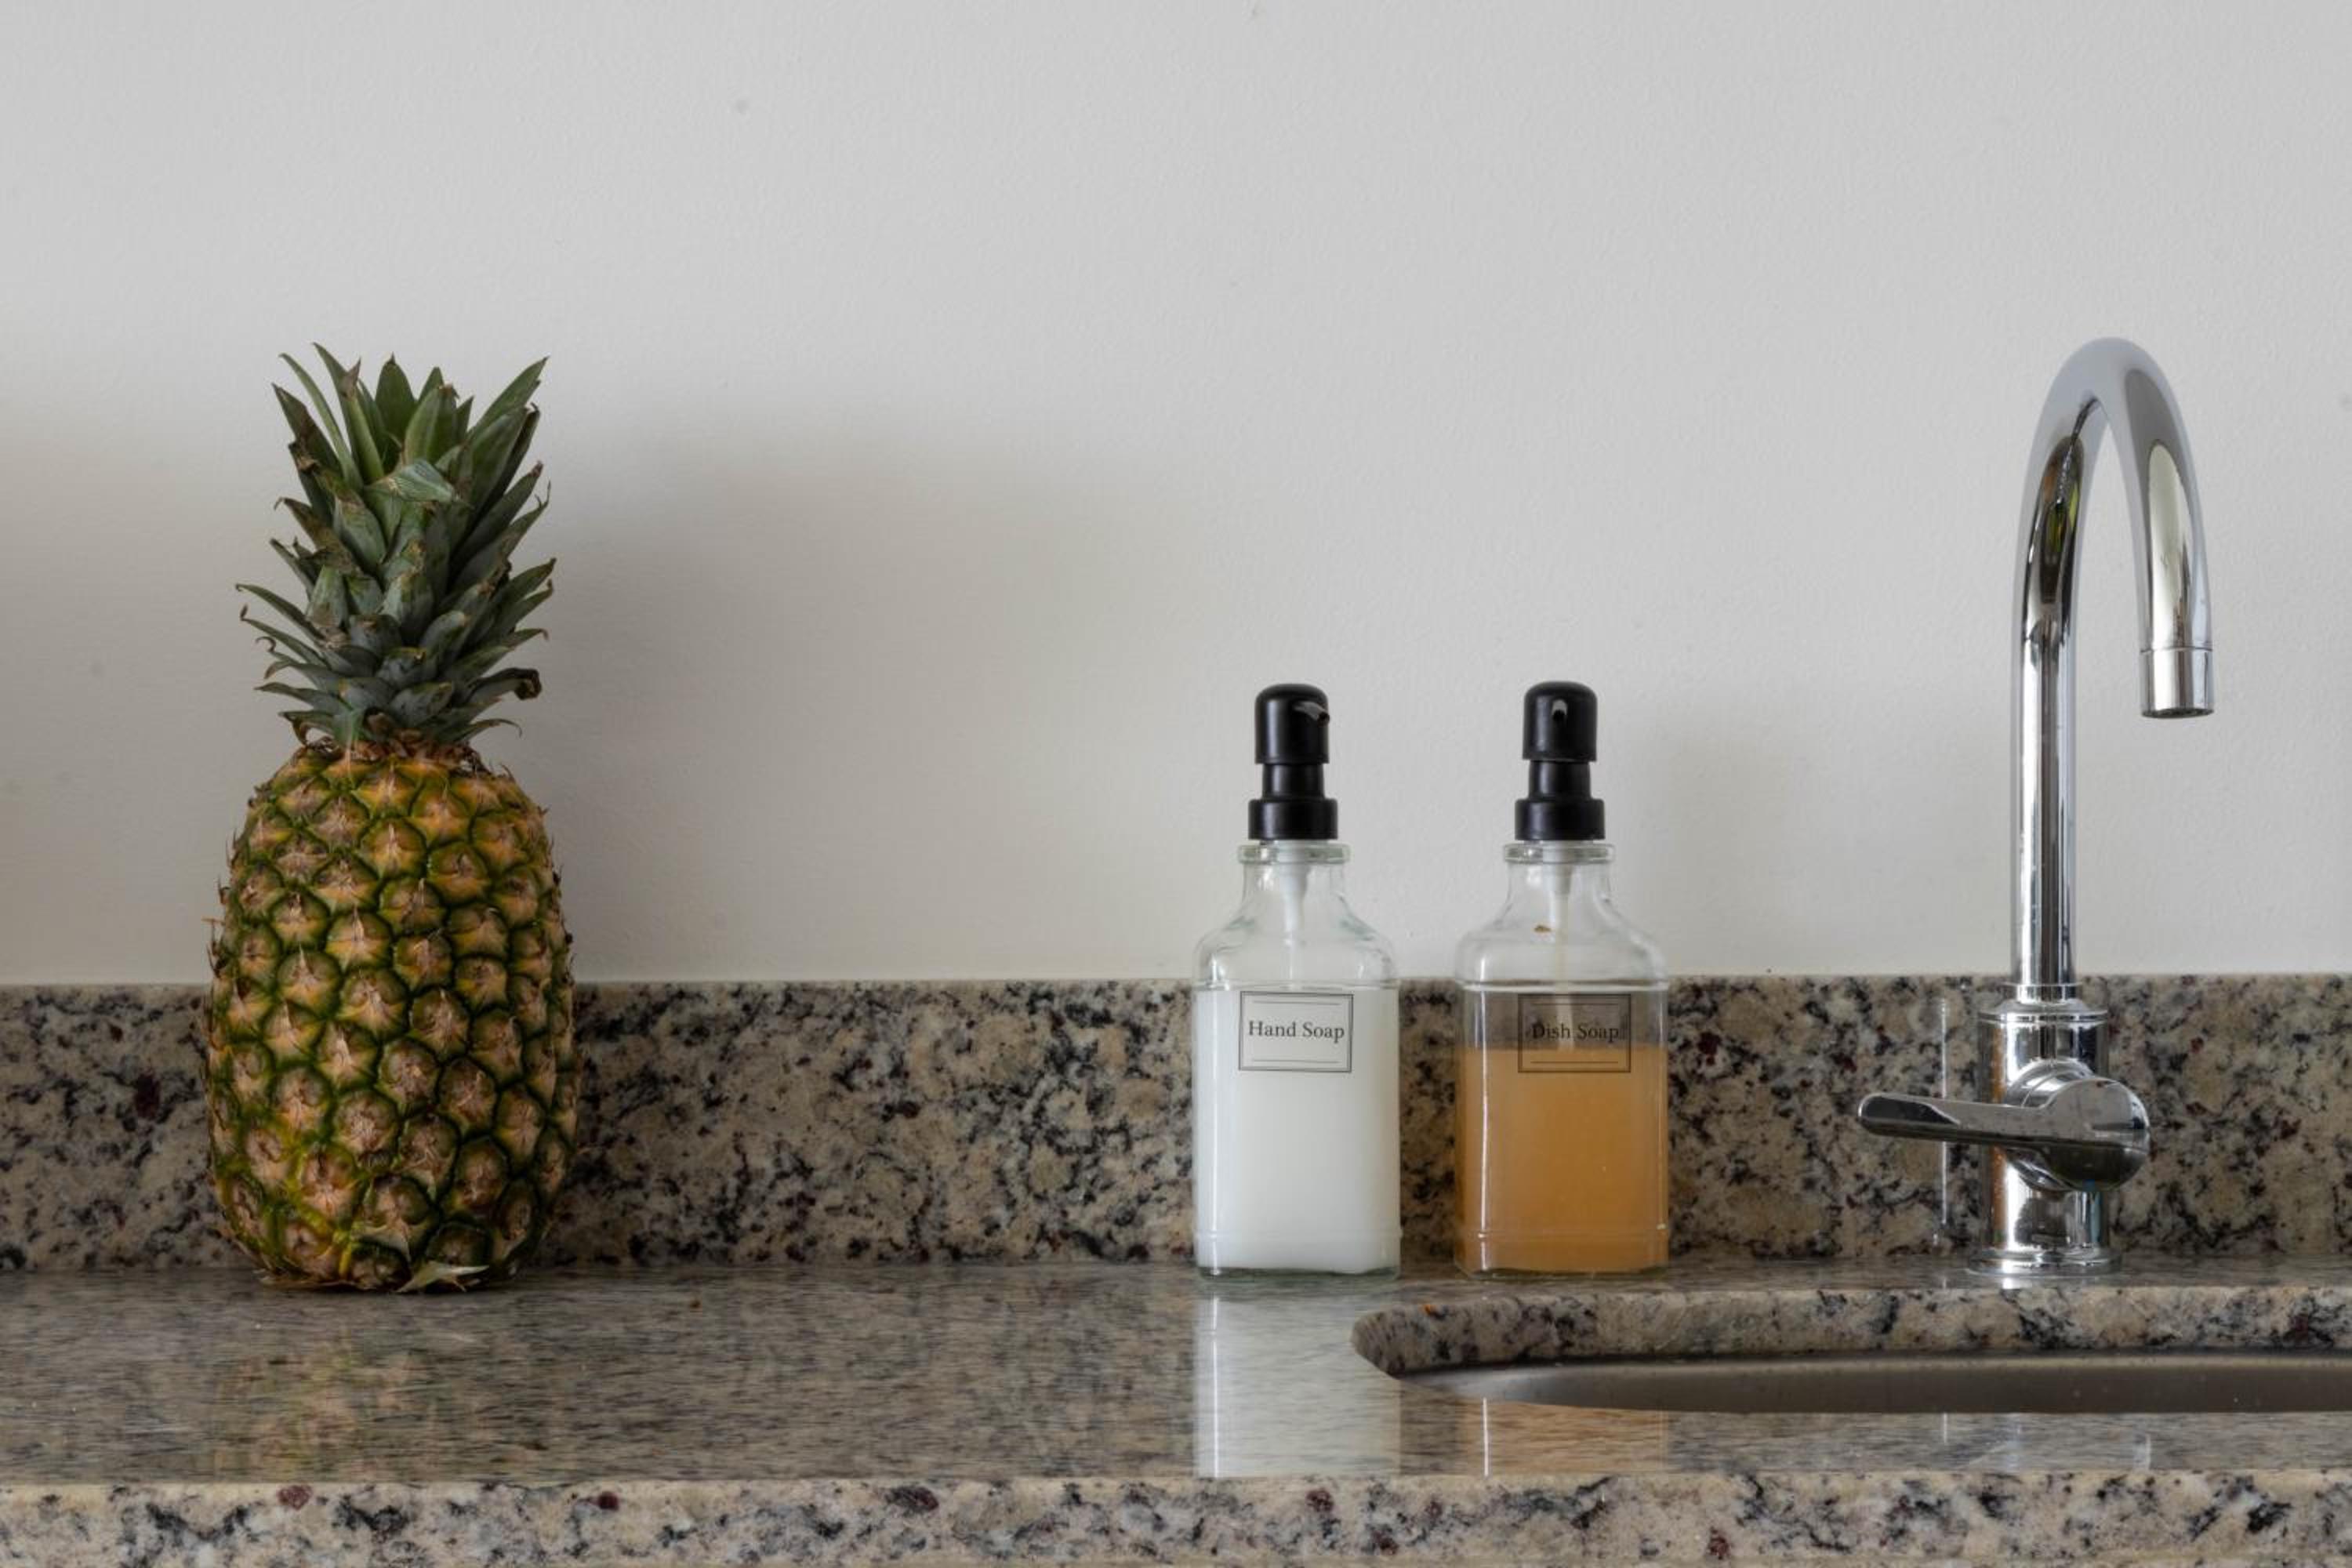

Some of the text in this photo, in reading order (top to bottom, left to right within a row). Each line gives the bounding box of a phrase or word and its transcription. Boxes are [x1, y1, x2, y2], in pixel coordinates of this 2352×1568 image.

[1249, 1020, 1345, 1044] Hand Soap
[1532, 1022, 1619, 1044] Dish Soap
